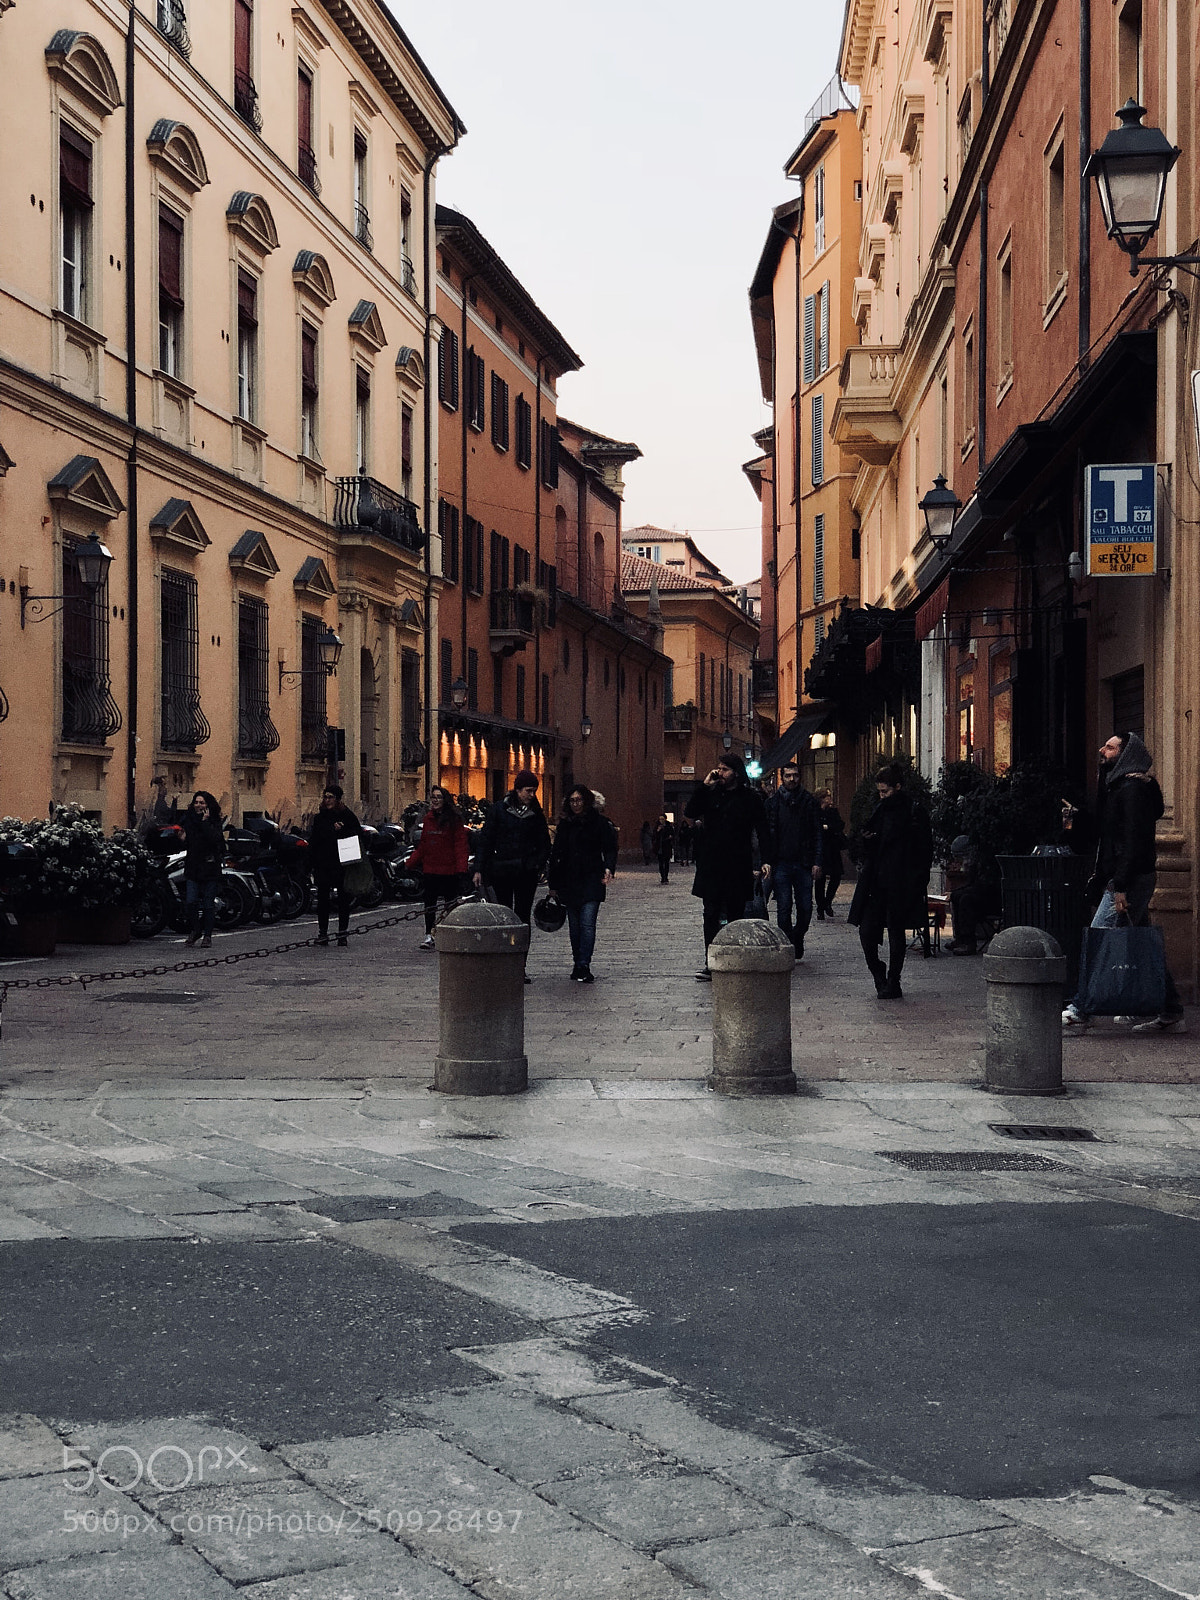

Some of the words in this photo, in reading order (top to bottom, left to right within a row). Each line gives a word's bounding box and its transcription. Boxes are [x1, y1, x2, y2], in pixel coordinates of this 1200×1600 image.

[1099, 469, 1142, 523] T
[1136, 512, 1148, 521] 37
[1110, 525, 1153, 535] TABACCHI
[1113, 545, 1132, 553] SELF
[1098, 553, 1147, 564] SERVICE
[1120, 564, 1135, 572] ORE
